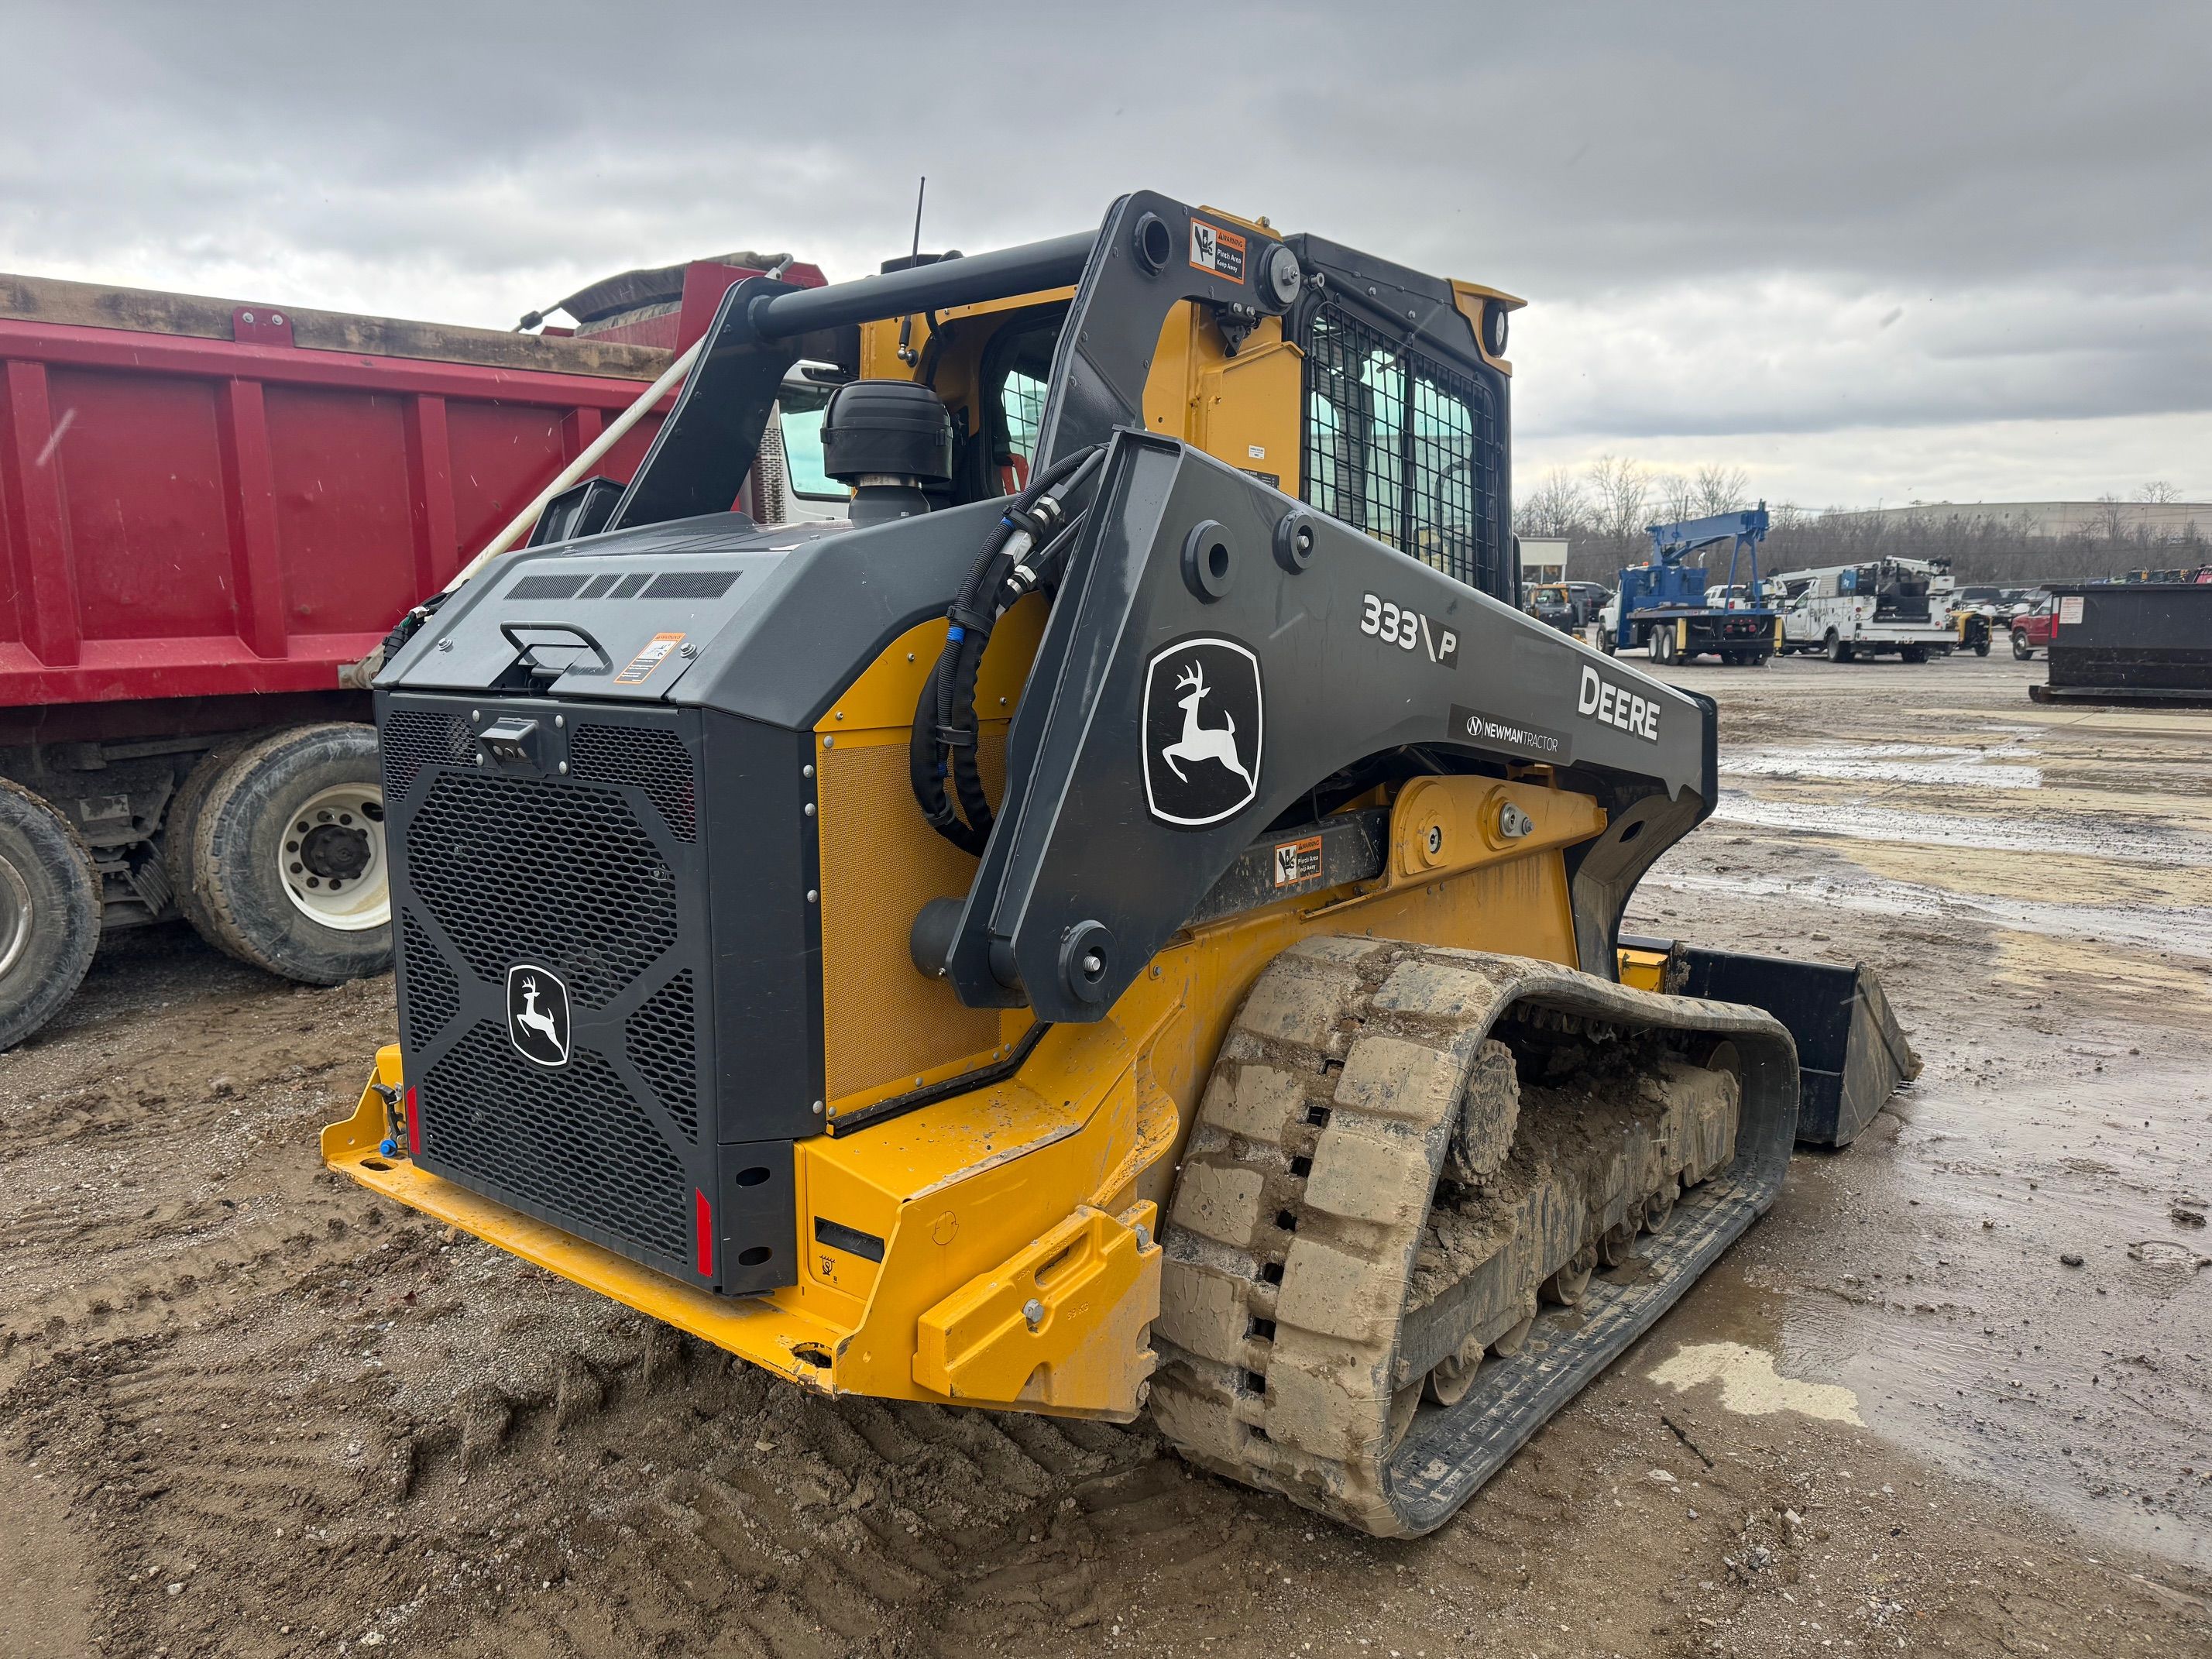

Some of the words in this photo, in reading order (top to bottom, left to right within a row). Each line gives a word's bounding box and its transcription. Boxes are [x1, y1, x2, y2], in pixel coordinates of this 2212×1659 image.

[1221, 234, 1243, 248] WARNING
[1217, 249, 1231, 260] Pinch
[1231, 254, 1242, 264] Area
[1217, 259, 1227, 269] Keep
[1227, 263, 1238, 273] Away
[1578, 665, 1661, 740] DEERE
